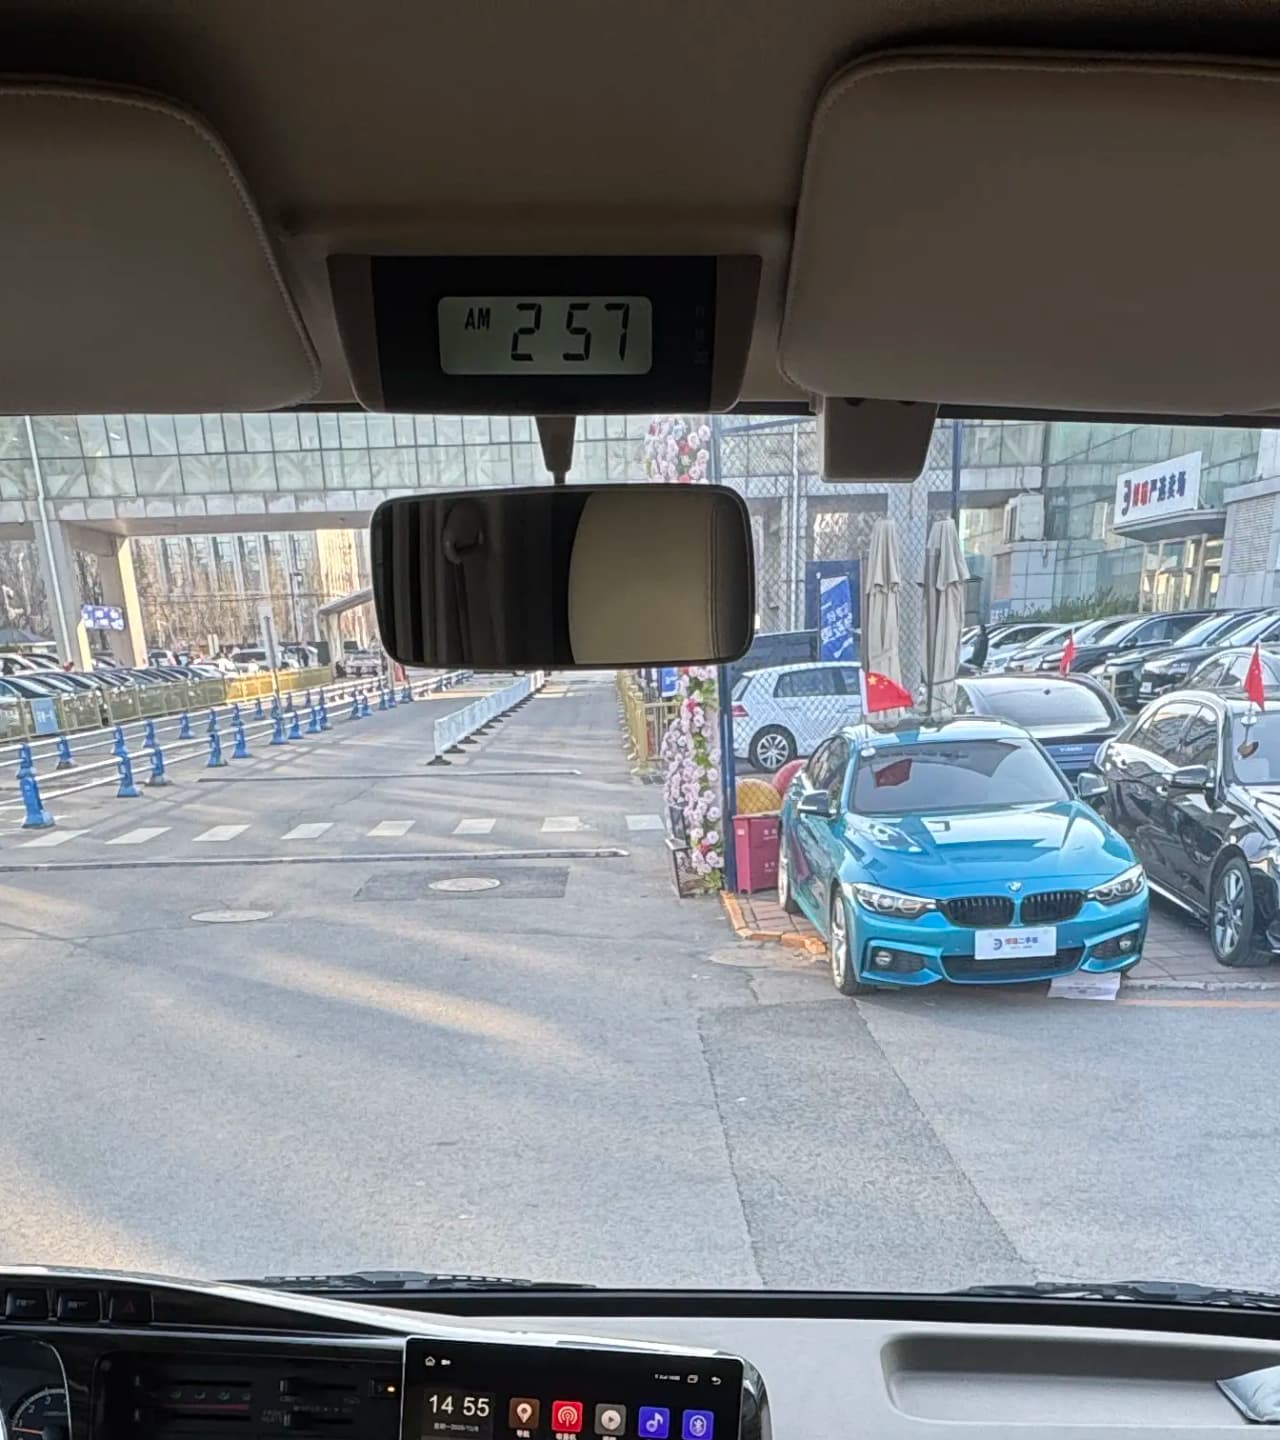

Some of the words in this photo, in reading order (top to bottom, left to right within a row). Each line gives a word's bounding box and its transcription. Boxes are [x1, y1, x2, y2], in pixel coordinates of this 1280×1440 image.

[464, 307, 490, 331] AM
[429, 1394, 454, 1415] 14
[463, 1396, 490, 1417] 55
